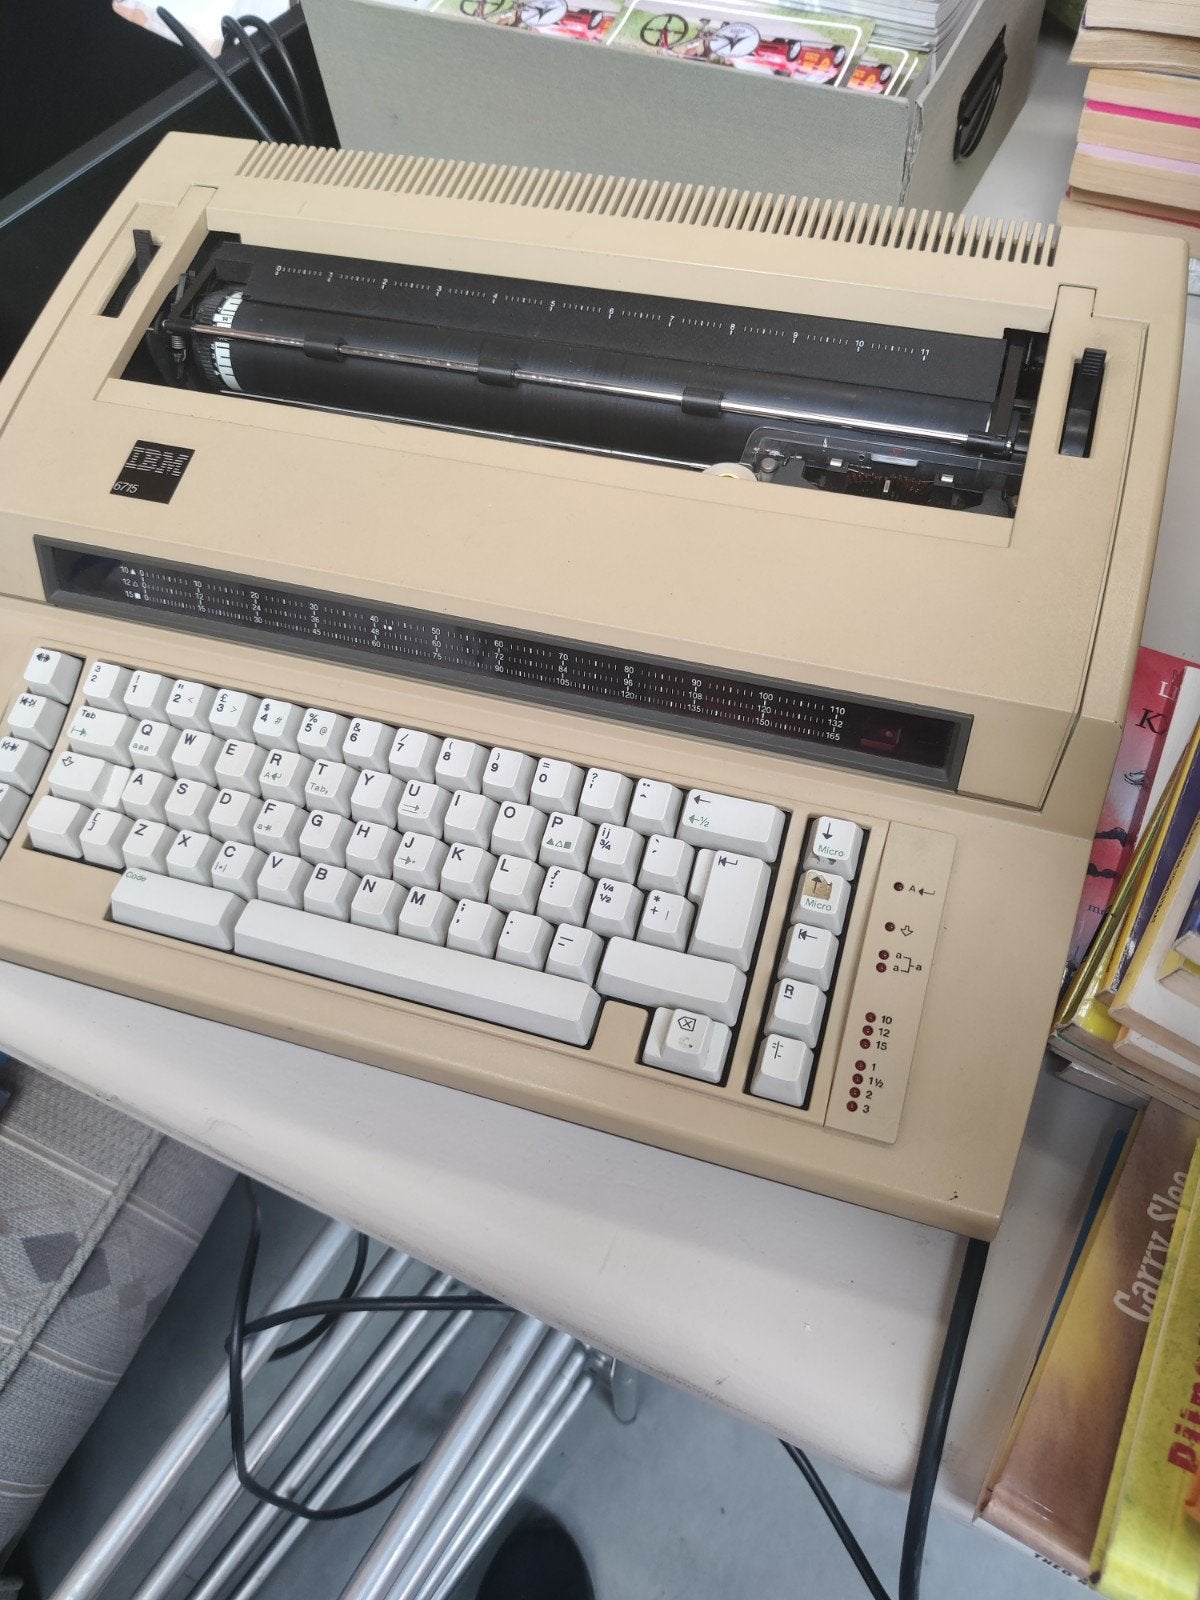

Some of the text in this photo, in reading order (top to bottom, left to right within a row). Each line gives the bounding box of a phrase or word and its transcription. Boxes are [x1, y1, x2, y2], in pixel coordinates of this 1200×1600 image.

[855, 340, 865, 348] 10
[125, 446, 189, 477] IBM
[113, 481, 139, 494] 6715
[193, 580, 202, 588] 10
[250, 591, 260, 600] 20
[309, 603, 319, 611] 30
[369, 615, 380, 623] 40
[431, 627, 441, 636] 50
[494, 640, 504, 648] 60
[558, 652, 569, 662] 70
[624, 665, 635, 674] 80
[691, 679, 702, 687] 90
[758, 692, 774, 701] 100
[830, 705, 845, 715] 110
[195, 592, 205, 601] 12
[252, 603, 262, 612] 24
[310, 615, 320, 624] 36
[370, 628, 380, 636] 48
[431, 640, 442, 648] 60
[494, 652, 504, 661] 72
[558, 665, 568, 674] 84
[623, 678, 634, 687] 96
[688, 691, 703, 700] 108
[757, 704, 772, 714] 120
[828, 718, 843, 728] 132
[312, 628, 321, 636] 45
[372, 639, 382, 648] 60
[494, 664, 504, 673] 90
[556, 677, 570, 687] 105
[621, 691, 635, 701] 120
[687, 704, 701, 713] 135
[755, 717, 770, 727] 150
[825, 731, 840, 741] 165
[172, 693, 182, 703] 2
[81, 709, 96, 720] Tab
[216, 703, 224, 713] 3
[260, 713, 268, 723] 4
[309, 712, 318, 723] %
[141, 724, 153, 736] Q
[304, 723, 312, 733] 5
[184, 733, 197, 746] W
[350, 733, 357, 742] 6
[225, 743, 238, 755] E
[269, 753, 282, 766] R
[442, 751, 451, 761] 8
[317, 763, 329, 775] T
[490, 762, 499, 772] 9
[133, 773, 143, 785] A
[364, 773, 375, 786] Y
[176, 783, 189, 795] S
[409, 784, 421, 797] U
[219, 792, 232, 805] D
[454, 794, 461, 807] I
[264, 802, 277, 814] F
[503, 806, 516, 819] O
[311, 814, 323, 828] G
[551, 816, 564, 829] P
[134, 823, 148, 836] Z
[357, 824, 371, 838] H
[177, 834, 192, 847] X
[405, 837, 415, 849] J
[224, 846, 236, 858] C
[451, 847, 465, 861] K
[818, 844, 844, 857] Micro
[272, 855, 284, 869] V
[500, 858, 509, 873] L
[125, 871, 147, 882] Code
[315, 868, 328, 881] B
[362, 879, 377, 893] N
[410, 891, 426, 906] M
[805, 898, 832, 911] Micro
[784, 984, 795, 998] R
[881, 1015, 893, 1025] 10
[878, 1028, 890, 1037] 12
[876, 1041, 887, 1050] 15
[872, 1063, 876, 1071] 1
[865, 1090, 873, 1100] 2
[862, 1104, 870, 1113] 3
[1113, 1230, 1170, 1323] Carry
